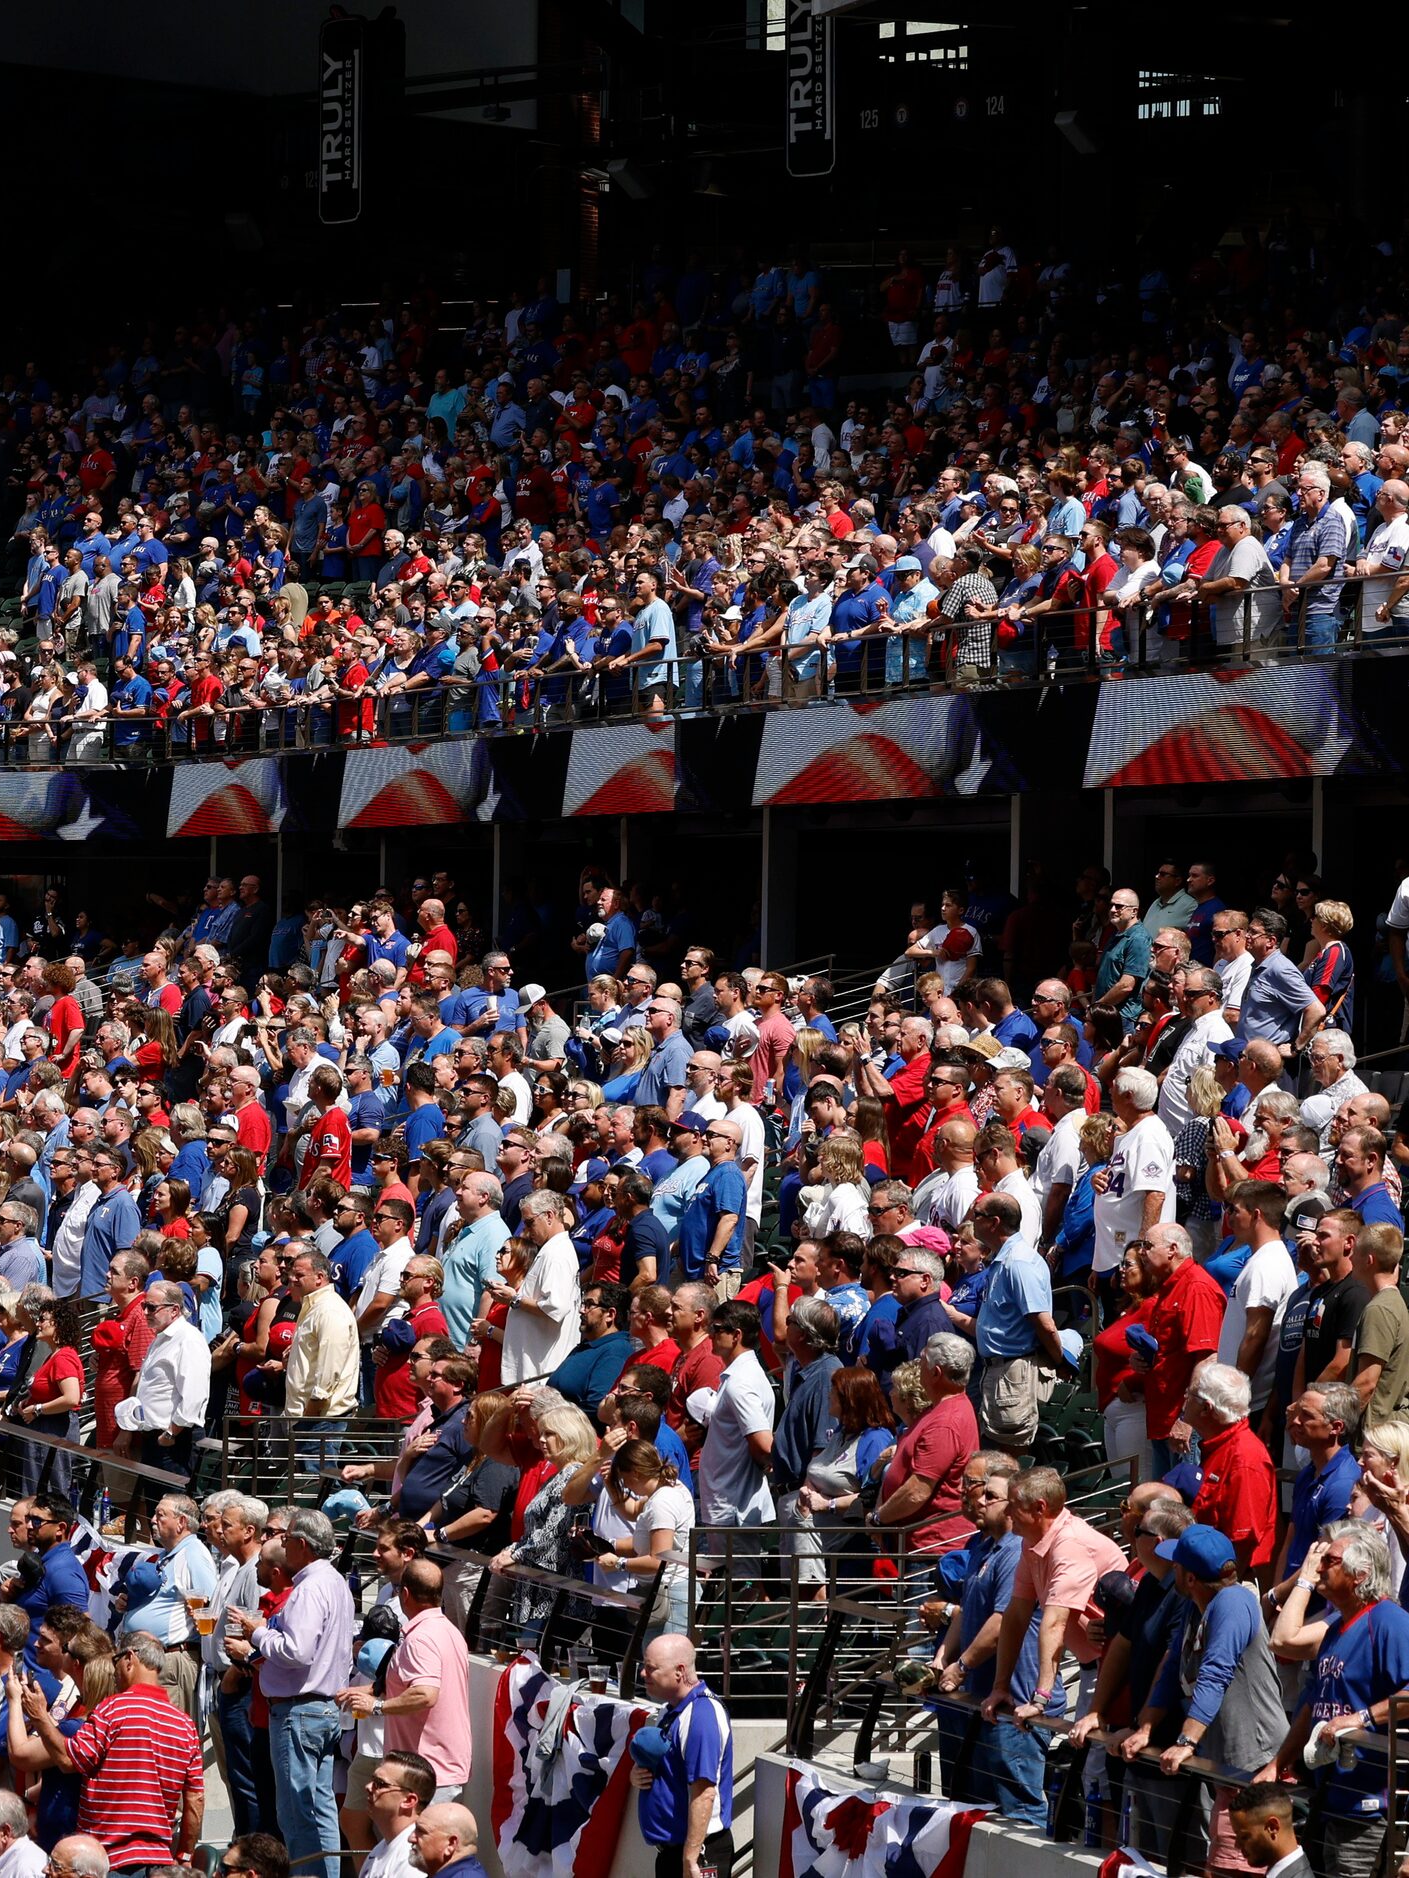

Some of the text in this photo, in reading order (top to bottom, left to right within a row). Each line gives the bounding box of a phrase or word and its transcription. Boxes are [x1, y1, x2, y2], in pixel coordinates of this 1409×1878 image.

[789, 0, 813, 143] TRULY
[815, 14, 823, 130] HARD SELTZE
[985, 95, 1005, 116] 124
[322, 51, 343, 193] TRULY
[344, 58, 352, 180] HARD SELTZER
[859, 108, 879, 129] 125
[347, 449, 354, 458] T
[80, 461, 98, 470] TEXAS
[657, 462, 668, 475] T
[464, 476, 476, 495] T
[204, 915, 214, 929] T
[965, 905, 992, 924] EXAS
[101, 1207, 109, 1218] T
[2, 1354, 10, 1363] T
[354, 1496, 364, 1506] T
[1318, 1655, 1344, 1679] TEXAS
[1312, 1702, 1352, 1718] NGERS
